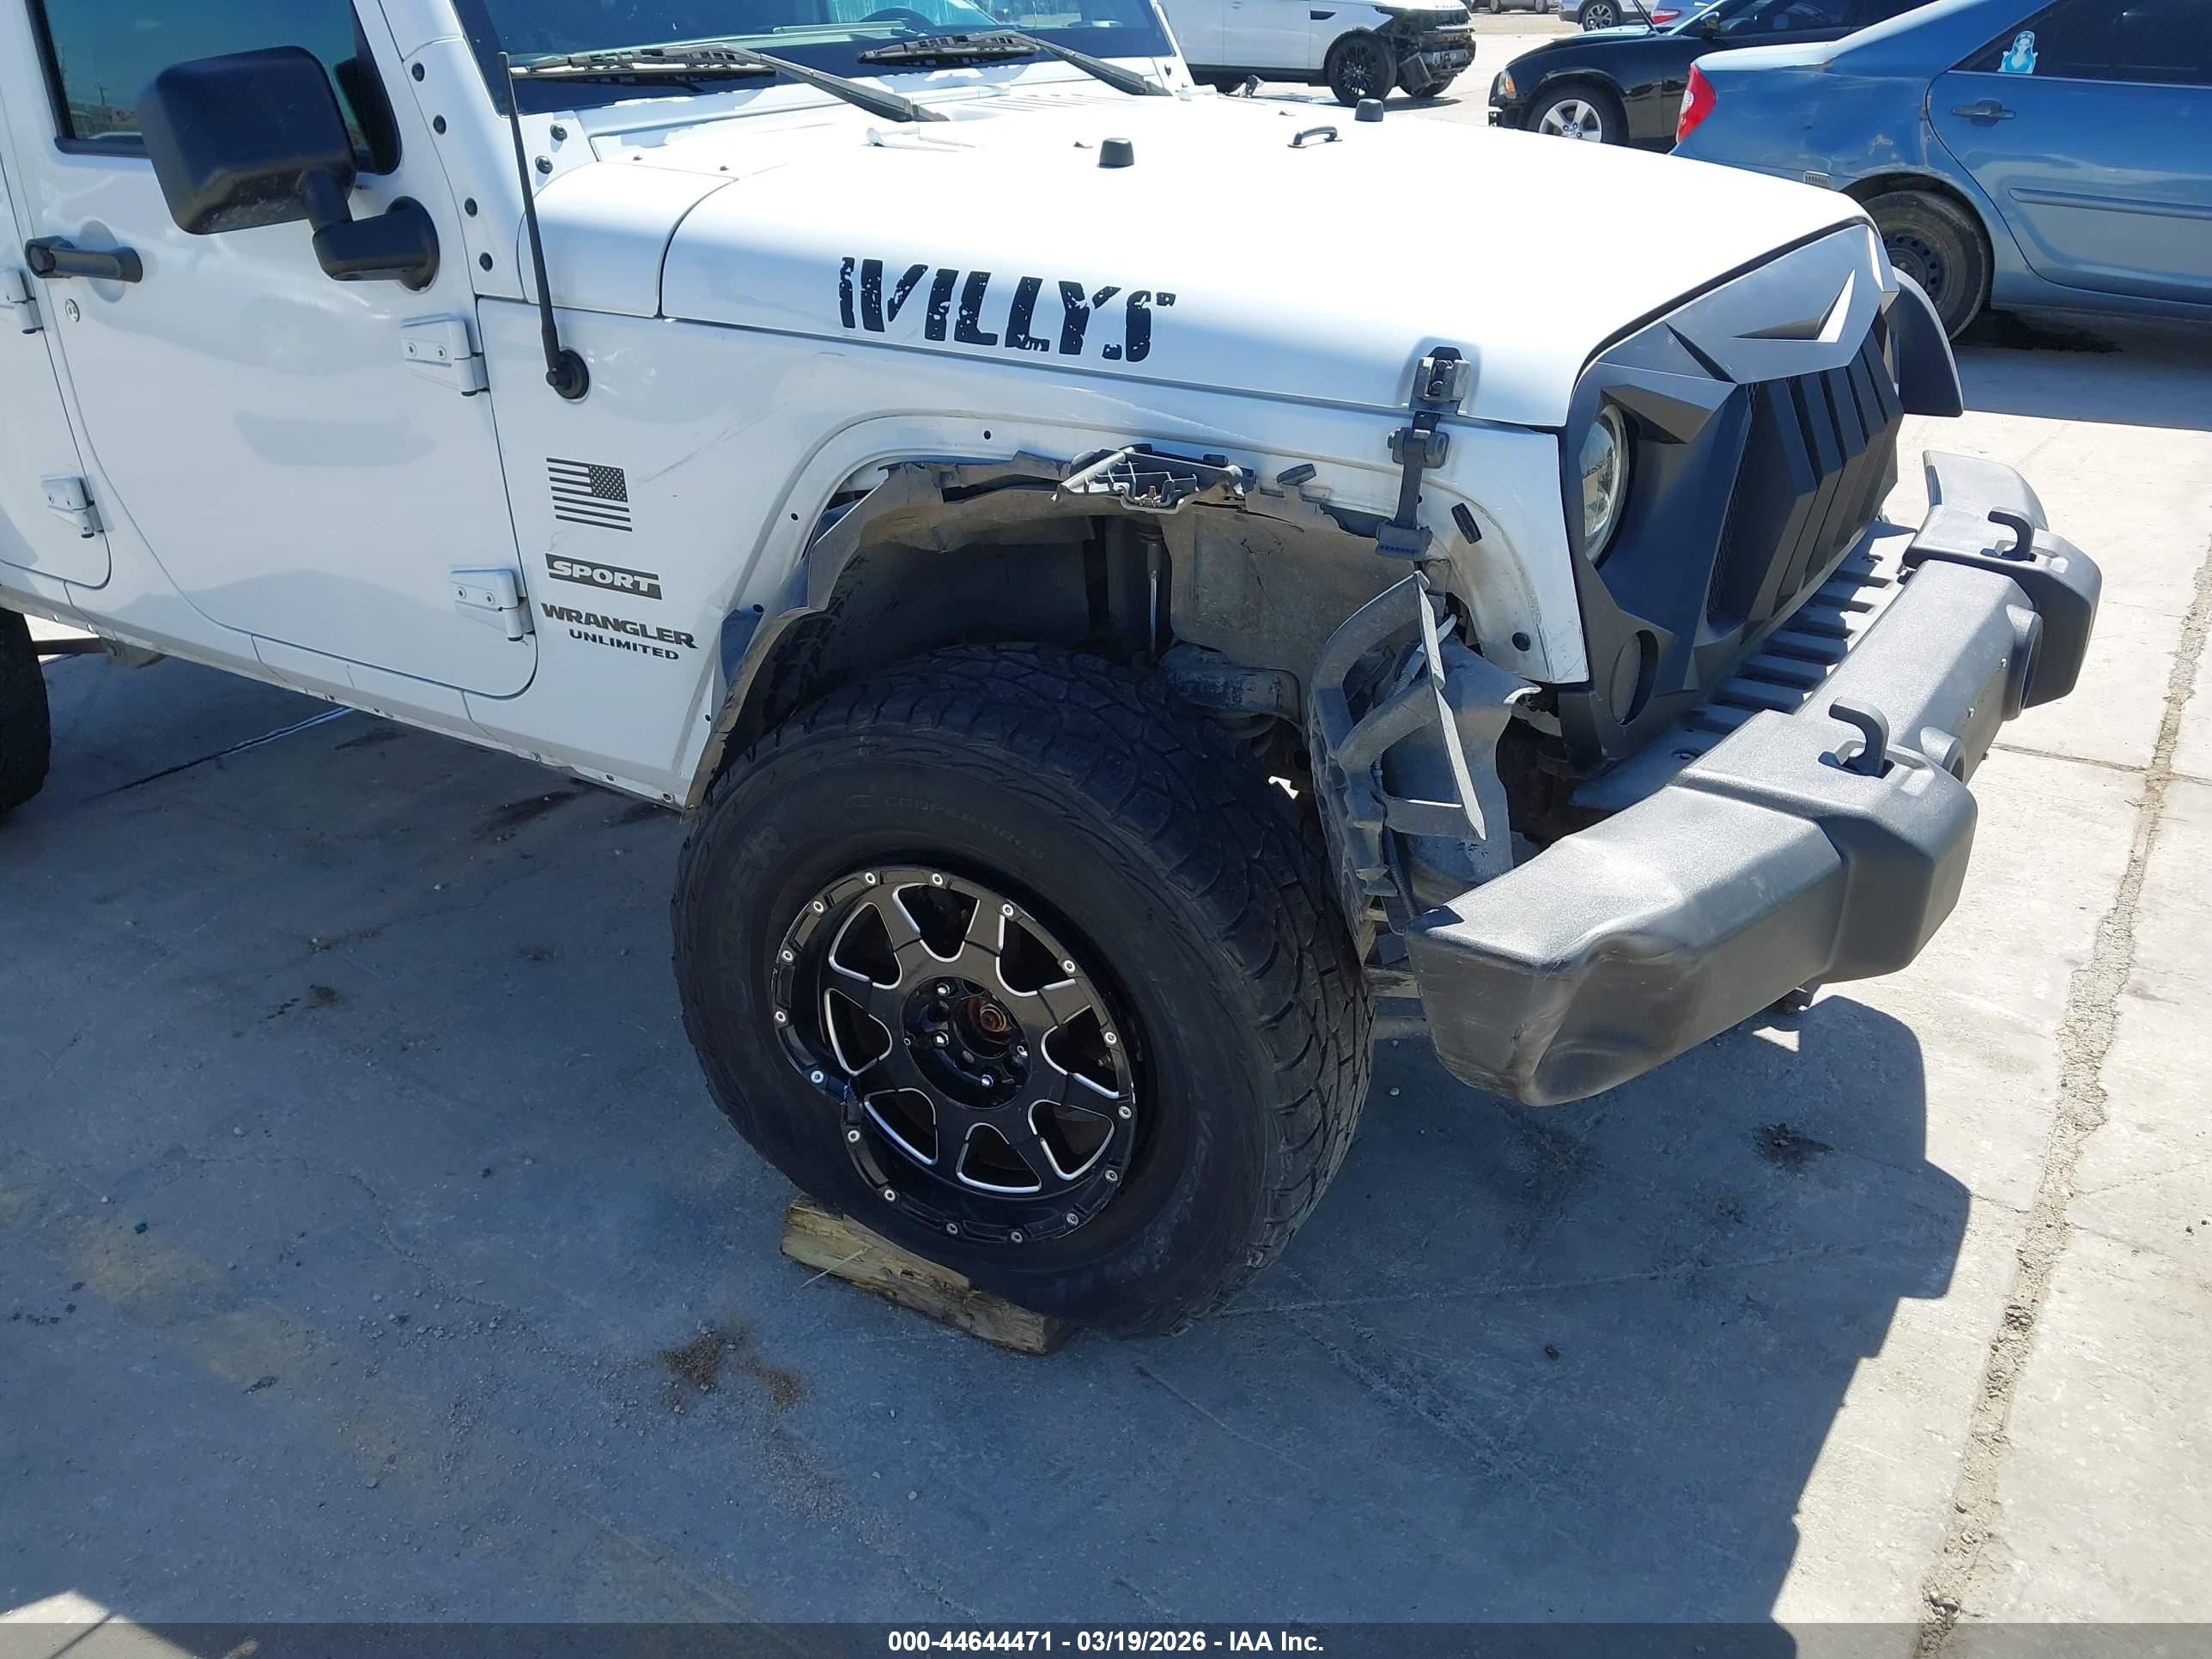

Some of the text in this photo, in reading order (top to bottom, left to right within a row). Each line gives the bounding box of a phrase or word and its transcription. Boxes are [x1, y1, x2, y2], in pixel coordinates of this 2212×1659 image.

[839, 257, 1176, 362] WILLYS
[549, 561, 659, 592] SPORT
[541, 603, 699, 648] WRANGLER
[569, 629, 678, 660] UNLIMITED
